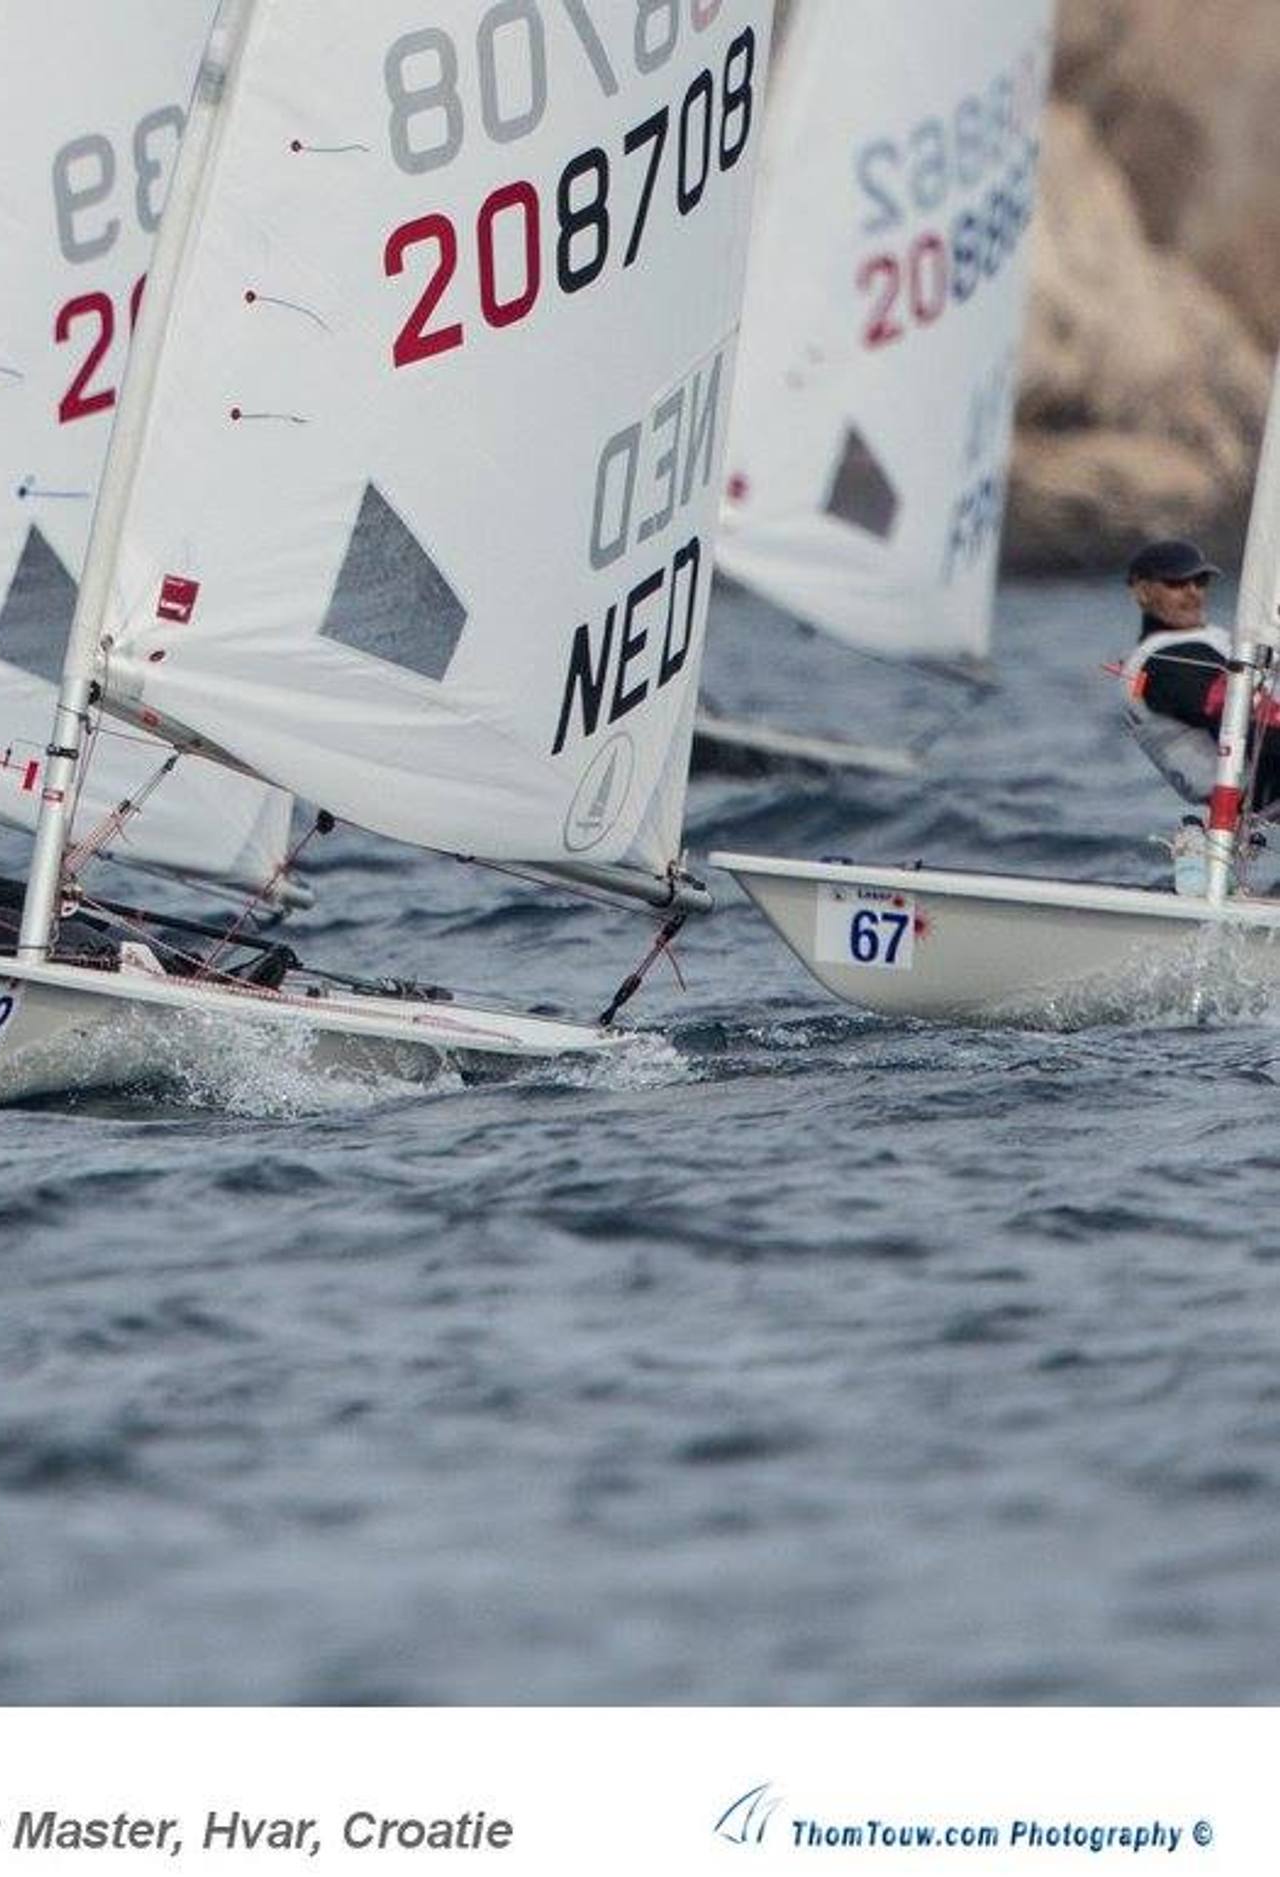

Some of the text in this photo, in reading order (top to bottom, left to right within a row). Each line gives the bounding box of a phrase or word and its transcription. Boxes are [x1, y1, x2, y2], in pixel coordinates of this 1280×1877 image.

[385, 26, 754, 367] 208708
[55, 272, 148, 425] 2
[552, 536, 701, 756] NED
[851, 910, 908, 963] 67
